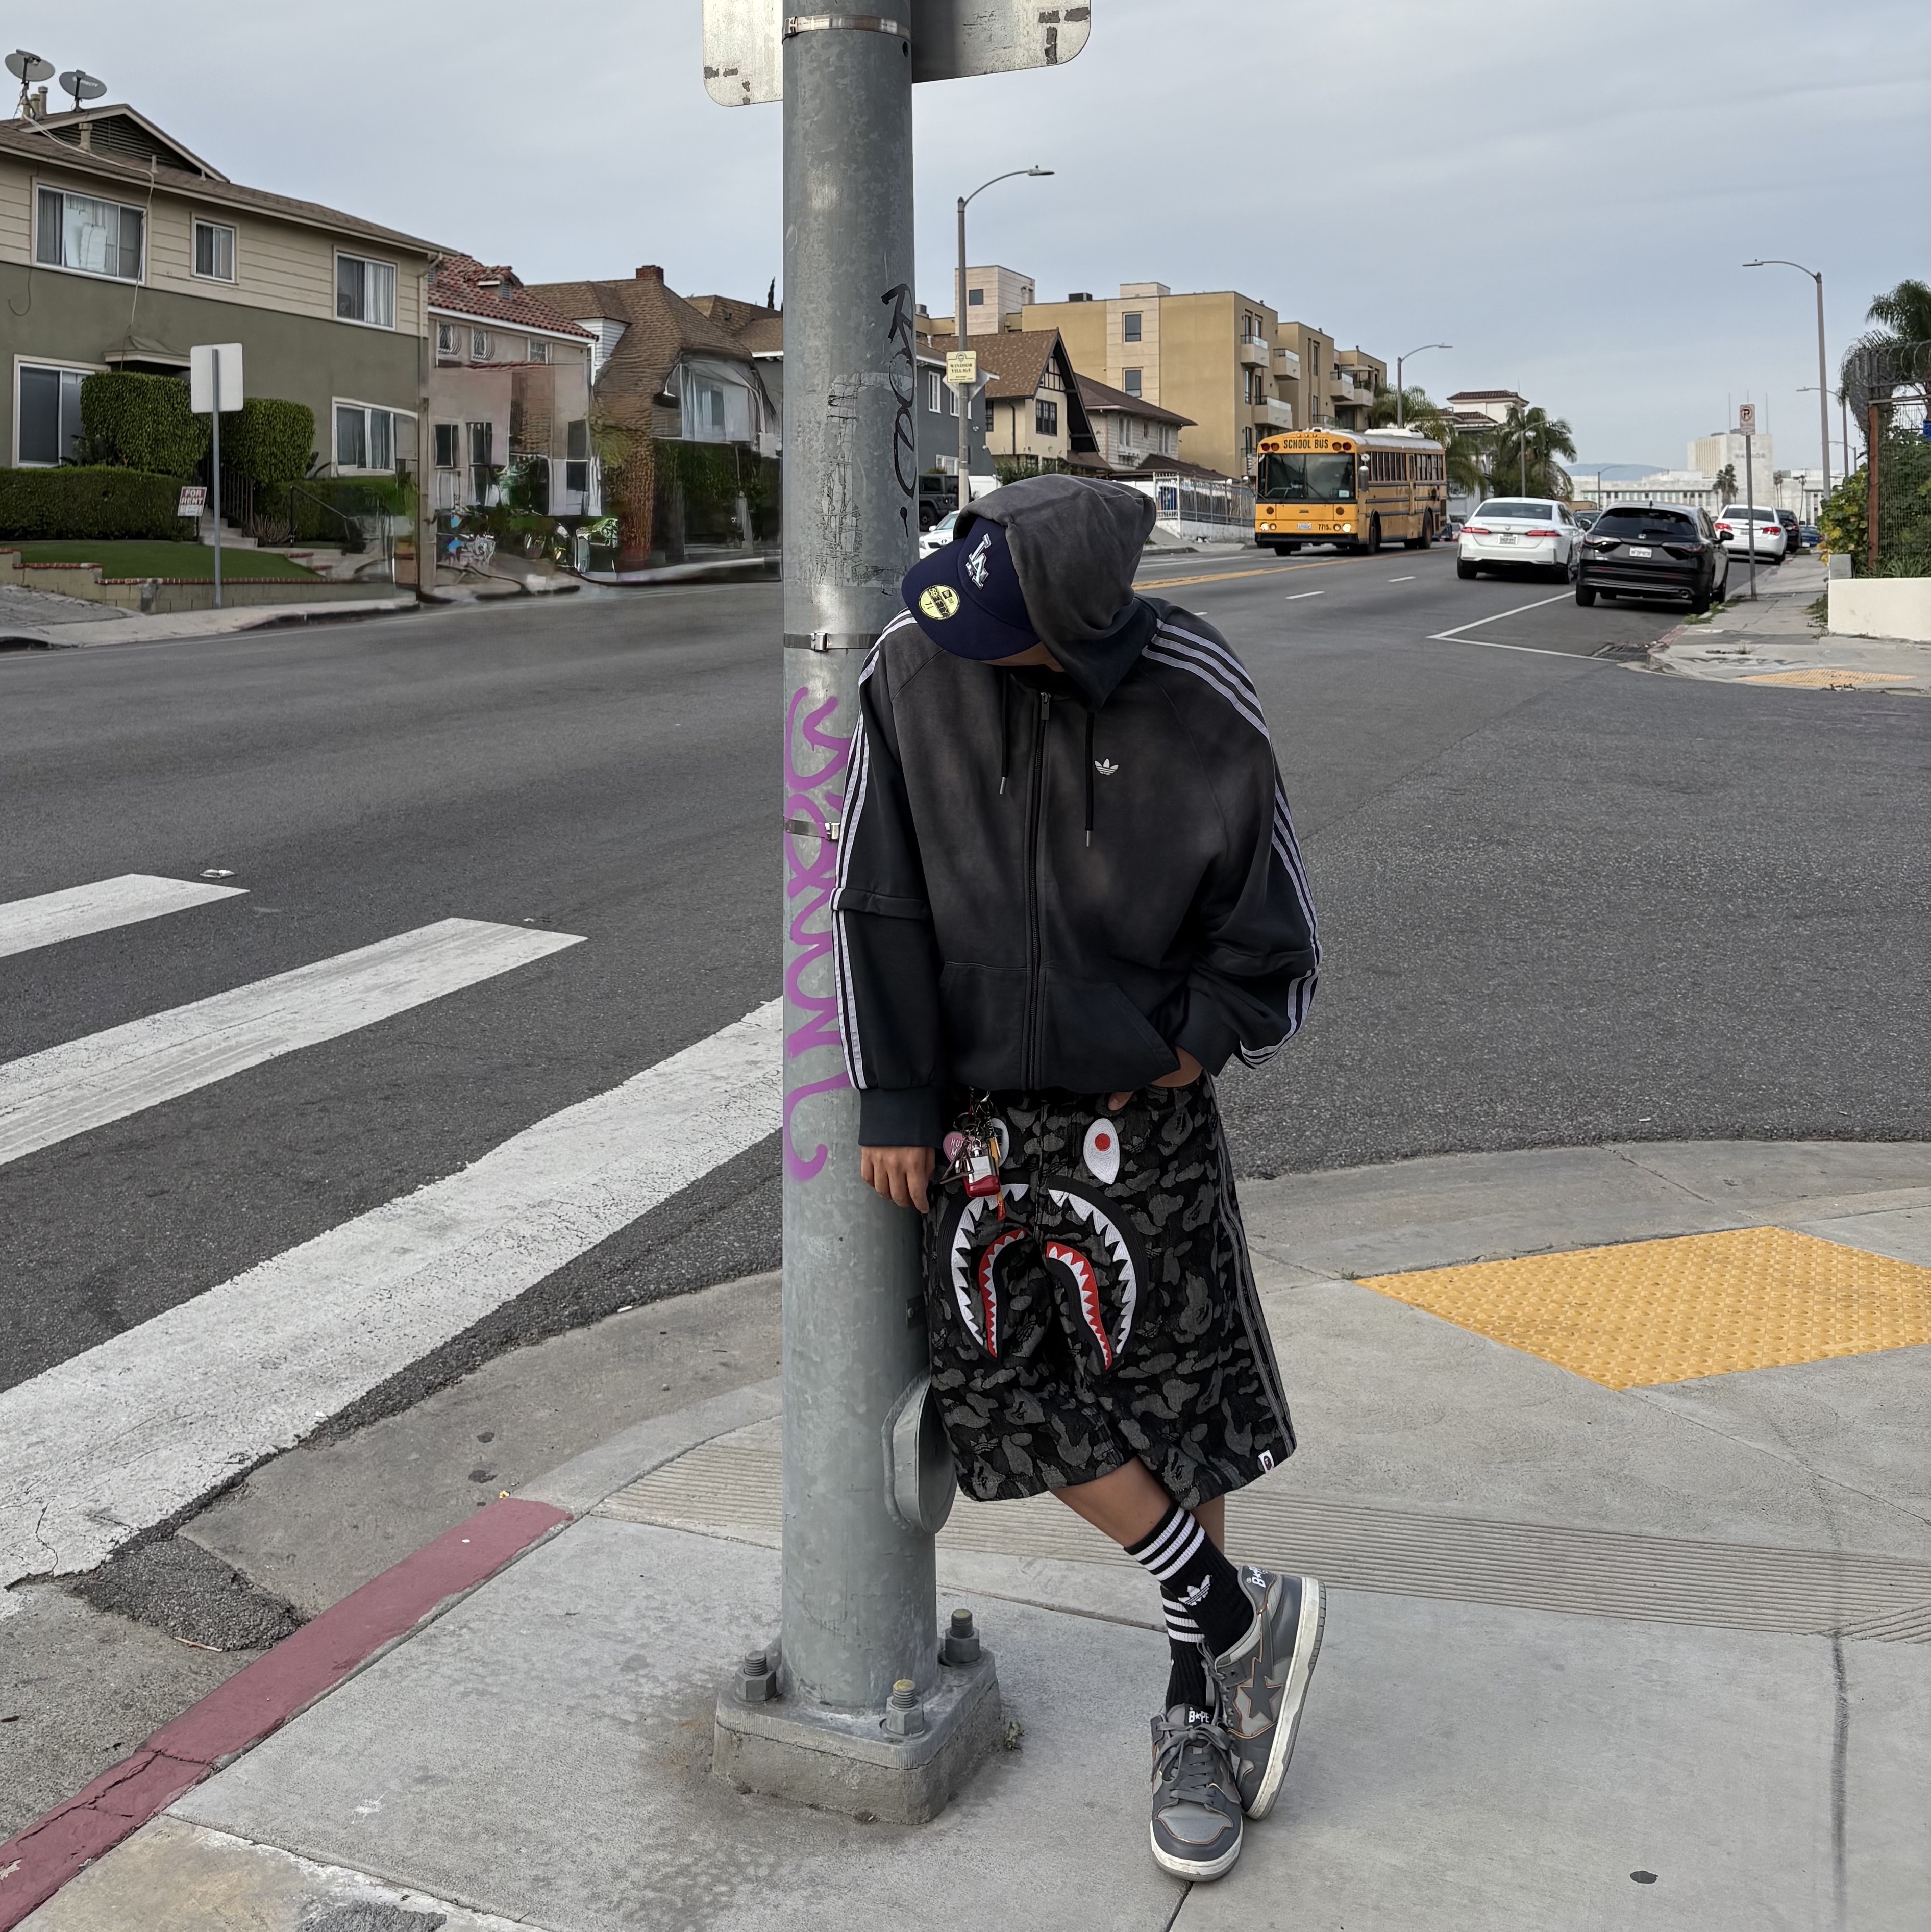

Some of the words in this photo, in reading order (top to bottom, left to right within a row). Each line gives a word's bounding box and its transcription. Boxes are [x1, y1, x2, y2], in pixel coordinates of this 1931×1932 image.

[1283, 439, 1311, 449] SCHOOL
[1315, 439, 1329, 449] BUS
[181, 497, 203, 505] RENT
